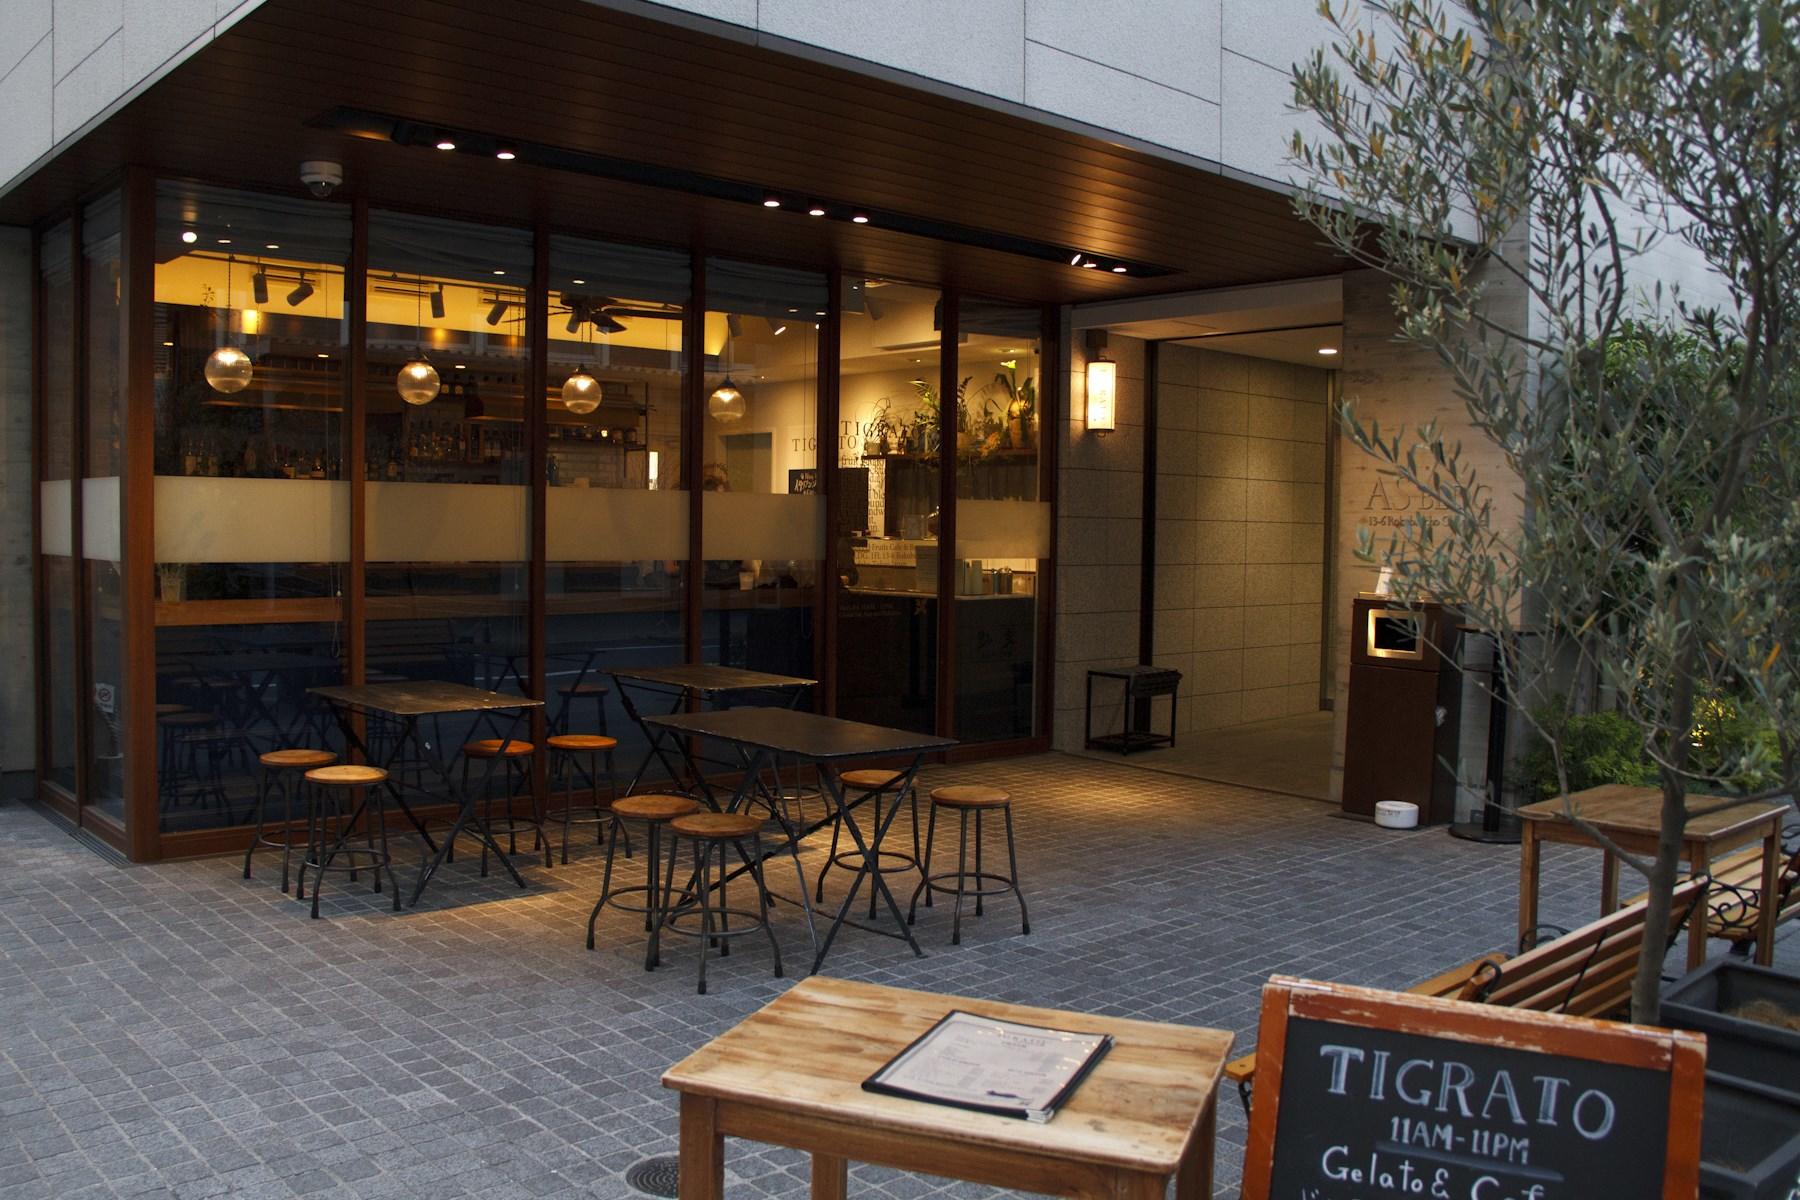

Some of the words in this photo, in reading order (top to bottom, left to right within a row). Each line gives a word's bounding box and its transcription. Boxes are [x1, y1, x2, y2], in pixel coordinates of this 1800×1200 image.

[1319, 1044, 1616, 1141] TIGRATO
[1390, 1116, 1530, 1165] 11AM-11PM
[1321, 1145, 1424, 1193] Gelato
[1431, 1167, 1450, 1199] &
